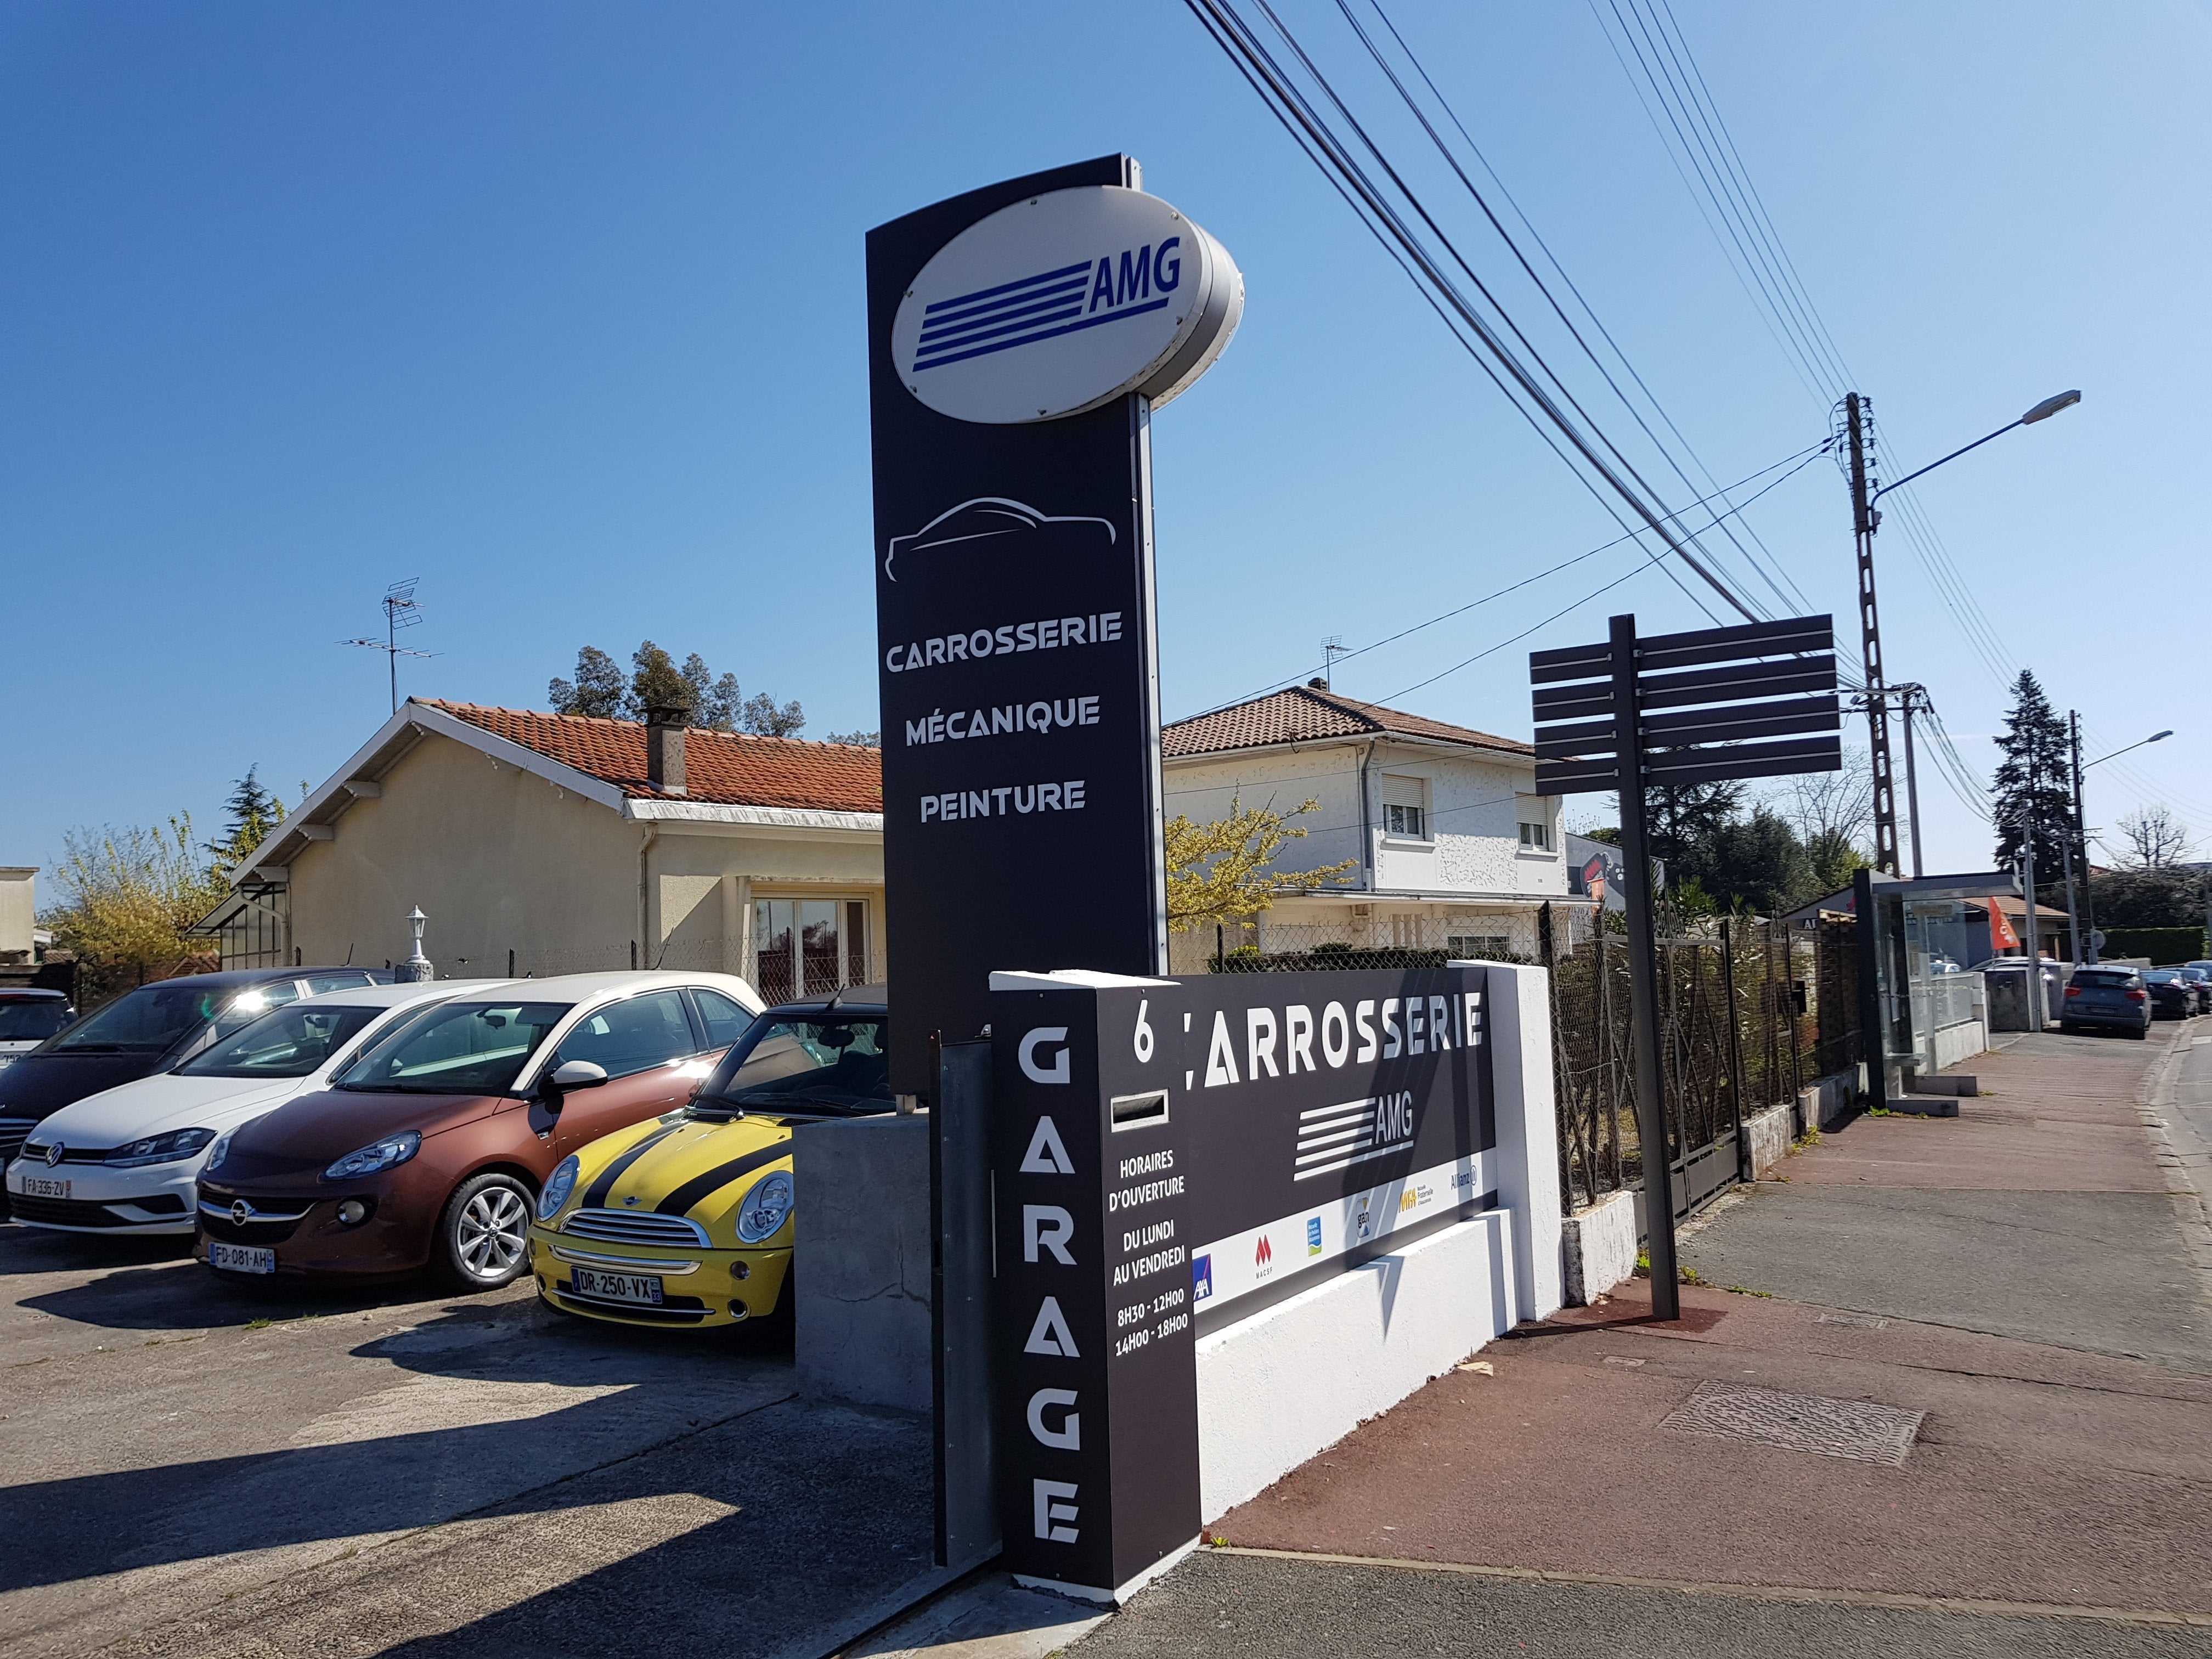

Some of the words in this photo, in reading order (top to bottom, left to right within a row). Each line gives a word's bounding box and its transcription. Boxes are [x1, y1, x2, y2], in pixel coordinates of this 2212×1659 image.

[1089, 236, 1181, 313] AMG
[886, 611, 1122, 673] CARROSSERIE
[906, 695, 1101, 747] MÉCANIQUE
[921, 781, 1086, 823] PEINTURE
[1133, 999, 1154, 1063] 6
[1184, 992, 1483, 1091] ARROSSERIE
[1375, 1090, 1413, 1144] AMG
[1120, 1149, 1173, 1178] HORAIRES
[1451, 1172, 1470, 1190] Allianz
[27, 1178, 64, 1195] FA-336-ZV
[1109, 1175, 1185, 1212] D'OUVERTURE
[1399, 1188, 1417, 1214] MFA
[1124, 1229, 1141, 1251] DU
[1143, 1219, 1174, 1246] LUNDI
[1357, 1210, 1369, 1229] gan
[216, 1246, 267, 1268] FD-081-AH
[1113, 1263, 1130, 1286] AU
[1132, 1245, 1185, 1279] VENDREDI
[1256, 1266, 1273, 1279] MACSF
[579, 1271, 651, 1299] DR-250-VX
[1018, 1026, 1081, 1544] GARAGE
[1193, 1278, 1210, 1301] AXA
[1118, 1303, 1145, 1327] 8H30
[1153, 1288, 1184, 1313] 12H00
[1115, 1329, 1149, 1356] 14H00
[1157, 1313, 1188, 1339] 18H00
